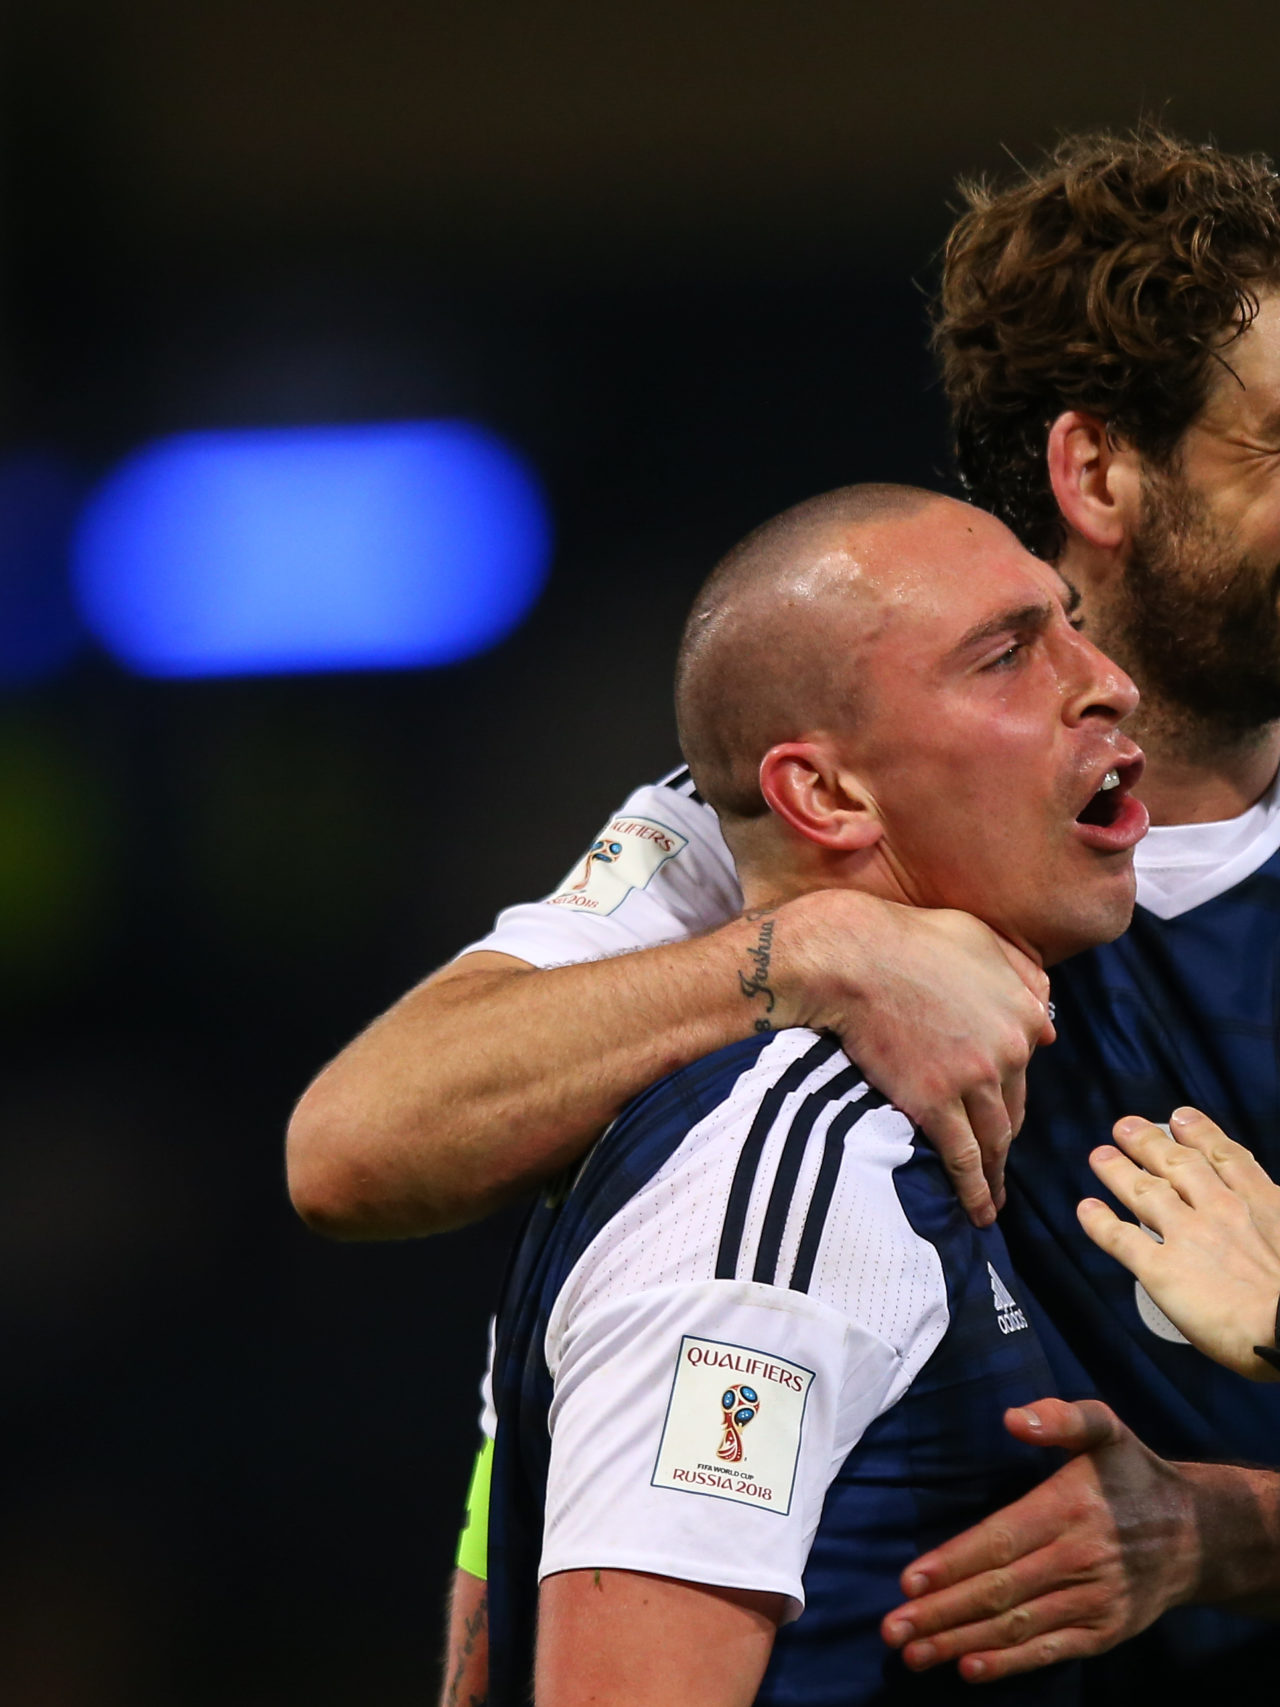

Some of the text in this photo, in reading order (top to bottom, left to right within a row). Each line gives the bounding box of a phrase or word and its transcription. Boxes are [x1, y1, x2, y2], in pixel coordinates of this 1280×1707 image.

[687, 1347, 804, 1393] QUALIFIERS
[672, 1468, 772, 1501] RUSSIA 2018
[697, 1463, 754, 1481] FIFA WORLD CUP
